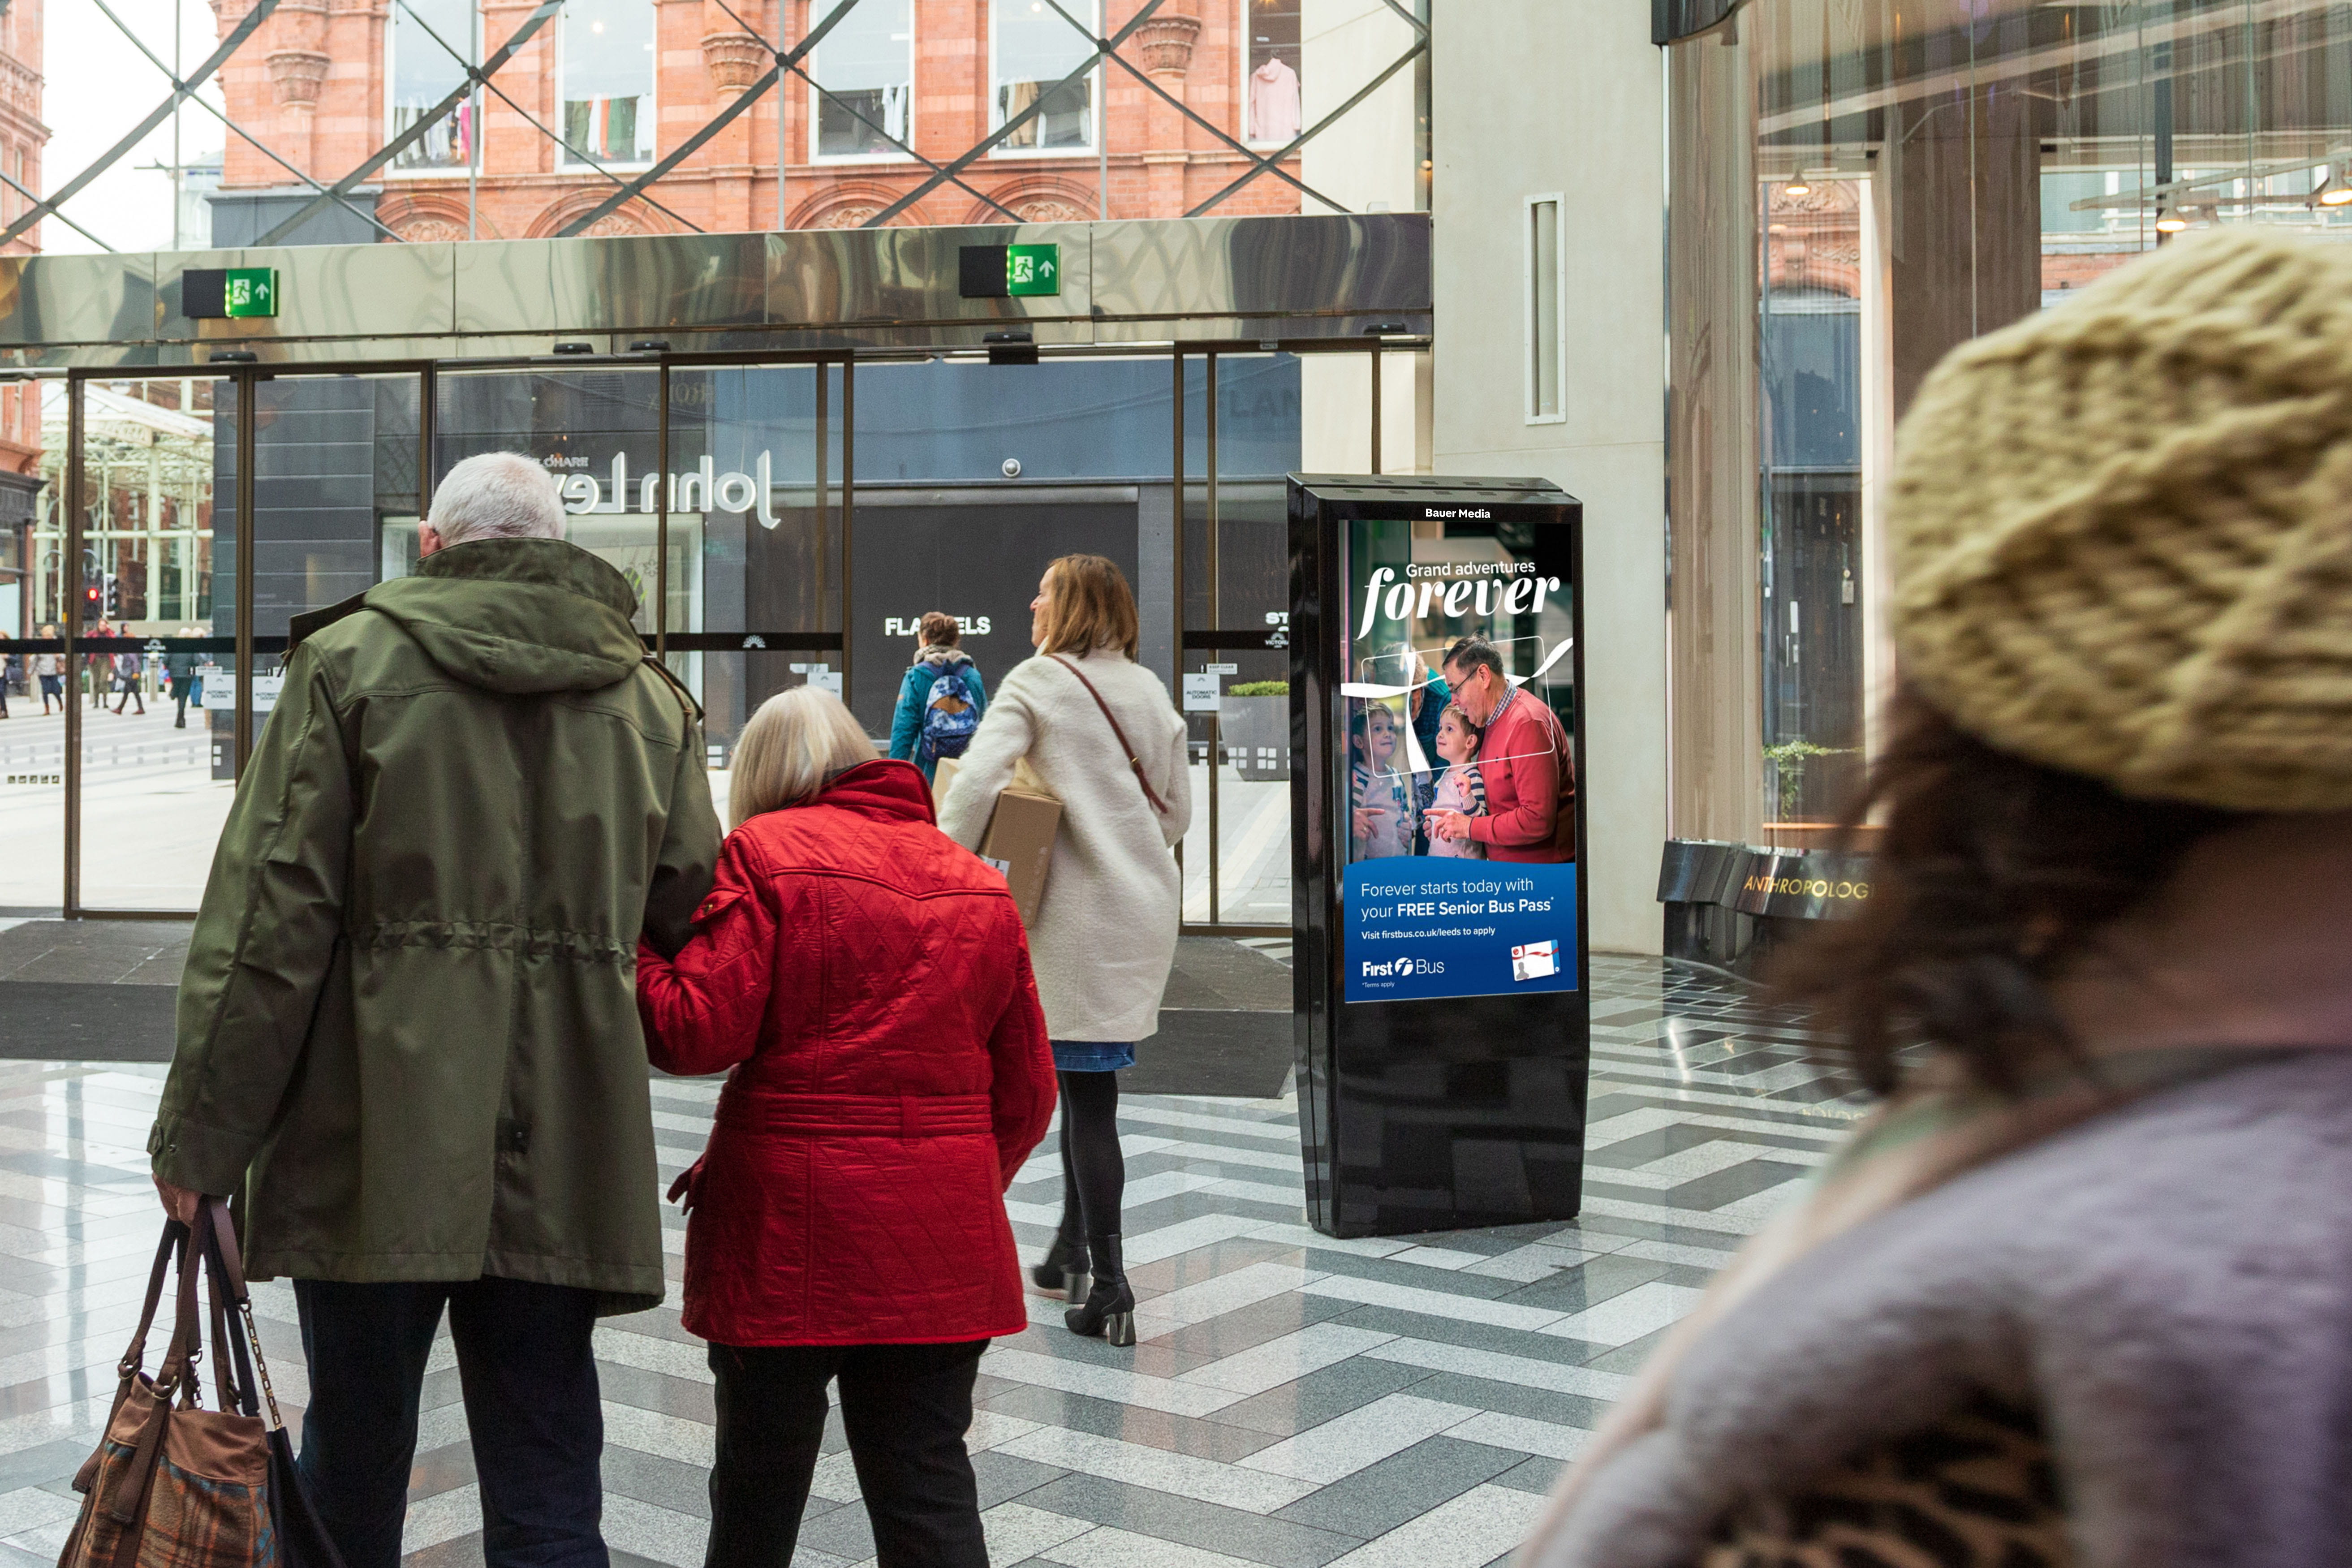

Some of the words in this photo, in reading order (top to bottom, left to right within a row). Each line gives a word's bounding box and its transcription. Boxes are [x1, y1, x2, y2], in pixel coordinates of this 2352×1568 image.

[1425, 508, 1456, 518] Bauer
[1458, 509, 1490, 518] Media
[1406, 562, 1451, 577] Grand
[1455, 561, 1536, 576] adventures
[1356, 566, 1560, 640] forever
[885, 616, 991, 636] FLAELS
[1361, 883, 1416, 897] Forever
[1420, 881, 1458, 895] starts
[1462, 879, 1502, 896] today
[1505, 877, 1533, 891] with
[1744, 875, 1869, 900] ANTHROPOLOG
[1361, 906, 1393, 922] your
[1397, 902, 1434, 917] FREE
[1439, 900, 1484, 915] Senior
[1488, 900, 1515, 913] Bus
[1361, 930, 1380, 940] Visit
[1382, 927, 1461, 939] firstbus.co.uk/leeds
[1473, 926, 1495, 936] apply
[1362, 961, 1393, 977] First
[1416, 959, 1445, 974] Bus
